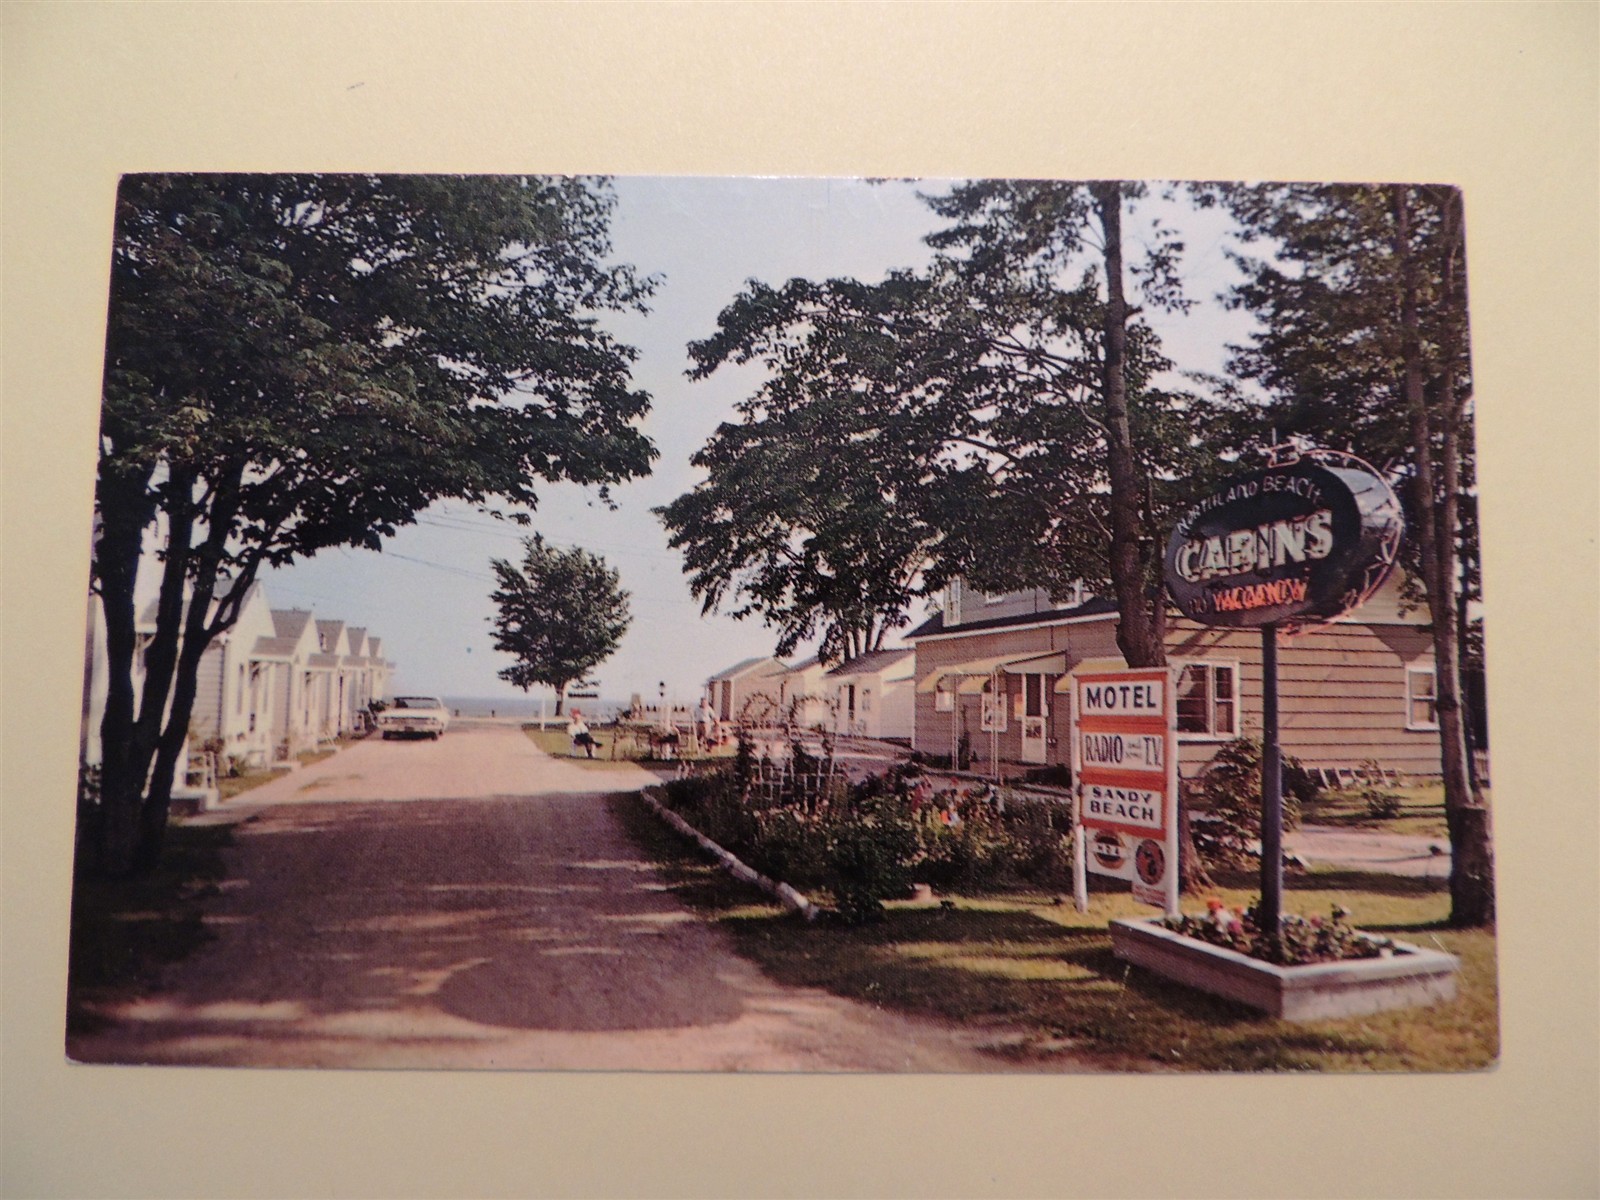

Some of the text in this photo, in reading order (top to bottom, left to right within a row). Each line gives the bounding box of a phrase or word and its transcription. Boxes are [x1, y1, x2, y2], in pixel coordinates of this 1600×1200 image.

[1176, 475, 1323, 535] NORTHLAND BEACH
[1174, 509, 1333, 582] CABINS
[1086, 685, 1156, 709] MOTEL
[1085, 734, 1123, 764] RADIO
[1092, 786, 1152, 804] SANDY
[1090, 800, 1154, 821] BEACH
